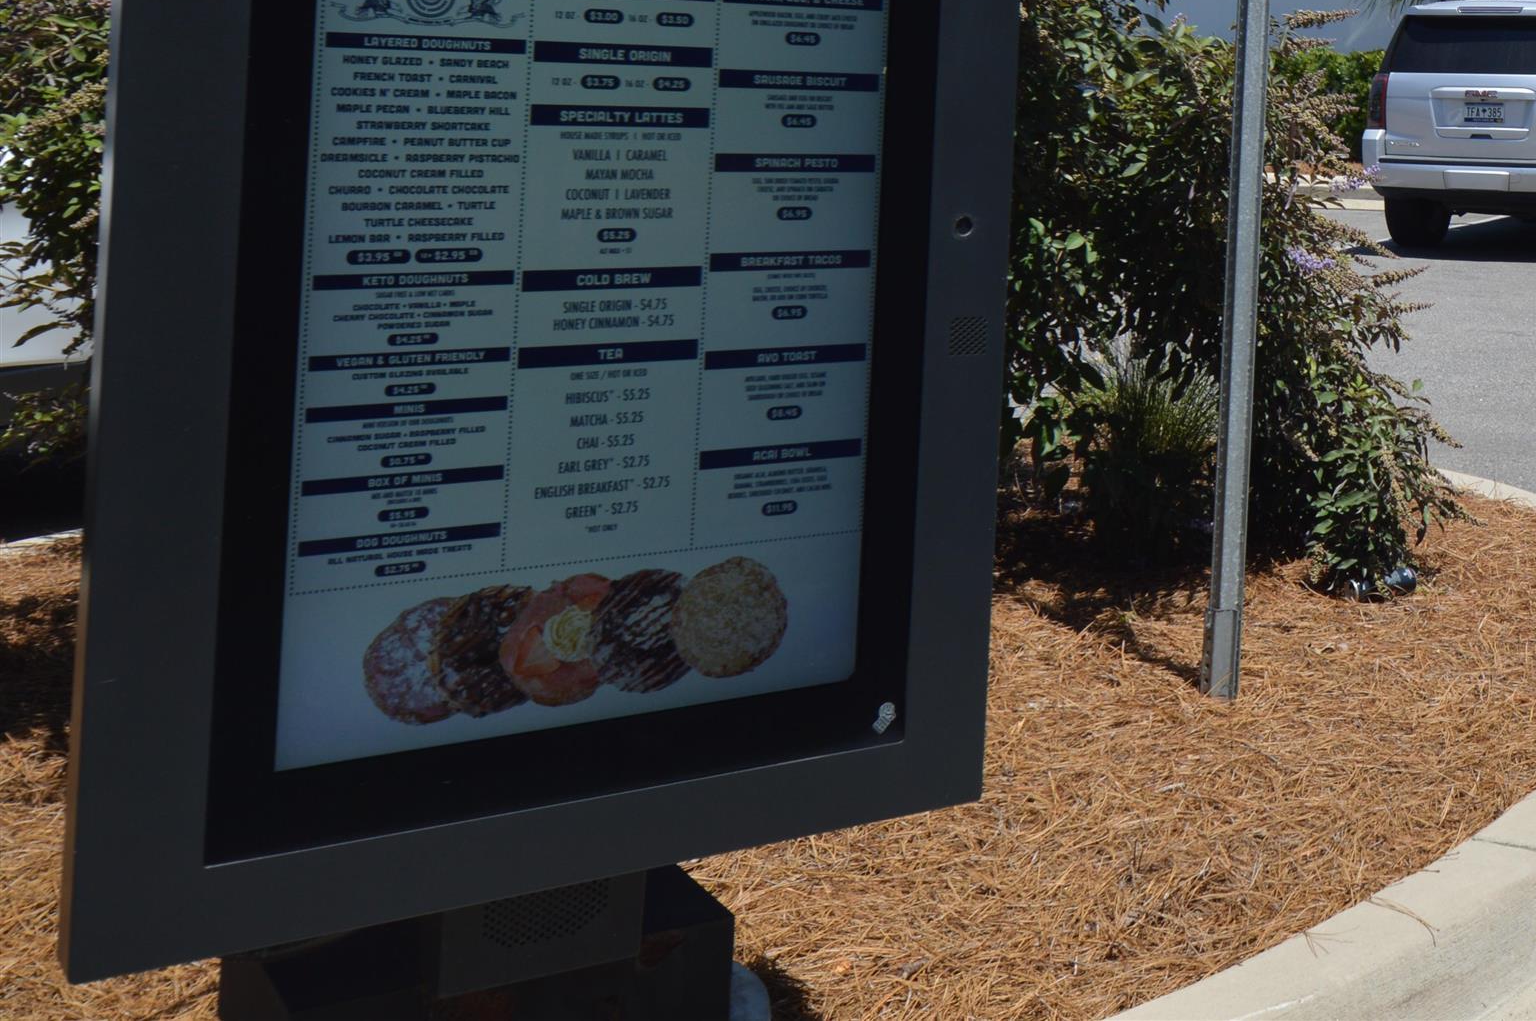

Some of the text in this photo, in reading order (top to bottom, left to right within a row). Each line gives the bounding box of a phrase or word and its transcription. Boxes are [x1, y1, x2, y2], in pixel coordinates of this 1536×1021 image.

[363, 36, 491, 50] LAYERED DOUGHNUTS
[578, 47, 671, 62] SINGLE ORIGIN
[342, 54, 509, 69] HONEY GLAZED SANDY BEACH
[352, 71, 498, 84] FRENCH TOAST CARNIVAL
[753, 74, 846, 87] SAUSAGE BISCUIT
[329, 86, 377, 97] COOKIES
[392, 88, 430, 98] CREAM
[446, 89, 481, 99] MAPLE
[483, 90, 517, 100] BACON
[335, 103, 511, 116] MAPLE PECAN BLUEBERRY HILL
[1487, 107, 1502, 118] 385
[559, 110, 683, 123] SPECIALTY LATTES
[355, 120, 491, 131] STRAWBERRY SHORTCAKE
[331, 136, 511, 147] CAMPFIRE PEANUT BUTTER CUP
[319, 153, 520, 163] DREAMSICLE RASPBERRY PISTACHIO
[572, 149, 668, 161] VANILLA CARAMEL
[754, 157, 838, 168] SPINACH PESTO
[357, 168, 484, 179] COCONUT CREAM FILLED
[585, 168, 654, 180] MAYAN MOCHA
[327, 184, 509, 195] CHURRO CHOCOLATE CHOCOLATE
[565, 187, 671, 201] COCONUT LAVENDER
[340, 200, 496, 211] BOURBON CARAMEL TURTLE
[560, 206, 673, 220] MAPLE & BROWN SUGAR
[363, 216, 473, 228] TURTLE CHEESECAKE
[327, 231, 504, 244] LEMON BAR RASPBERRY FILLED
[740, 254, 841, 267] BREAKFAST TACOS
[362, 273, 469, 286] KETO DOUGHNUTS
[576, 272, 651, 286] COLD BREW
[562, 300, 596, 314] SINGLE
[598, 298, 632, 312] ORIGIN
[553, 317, 586, 331] HONEY
[588, 315, 640, 330] CINNAMON
[335, 350, 485, 367] VEGAN & GLUTEN FRIENDLY
[597, 347, 623, 360] TEA
[757, 350, 817, 363] AVO TOAST
[393, 403, 425, 415] MINIS
[569, 413, 608, 428] MATCHA
[576, 435, 599, 450] CHAI
[752, 446, 812, 461] ACAI BOWL
[557, 459, 581, 474] EARL
[367, 472, 443, 488] BOX OF MINIS
[534, 483, 575, 500] ENGLISH
[355, 529, 447, 548] DOG DOUGHNUTS
